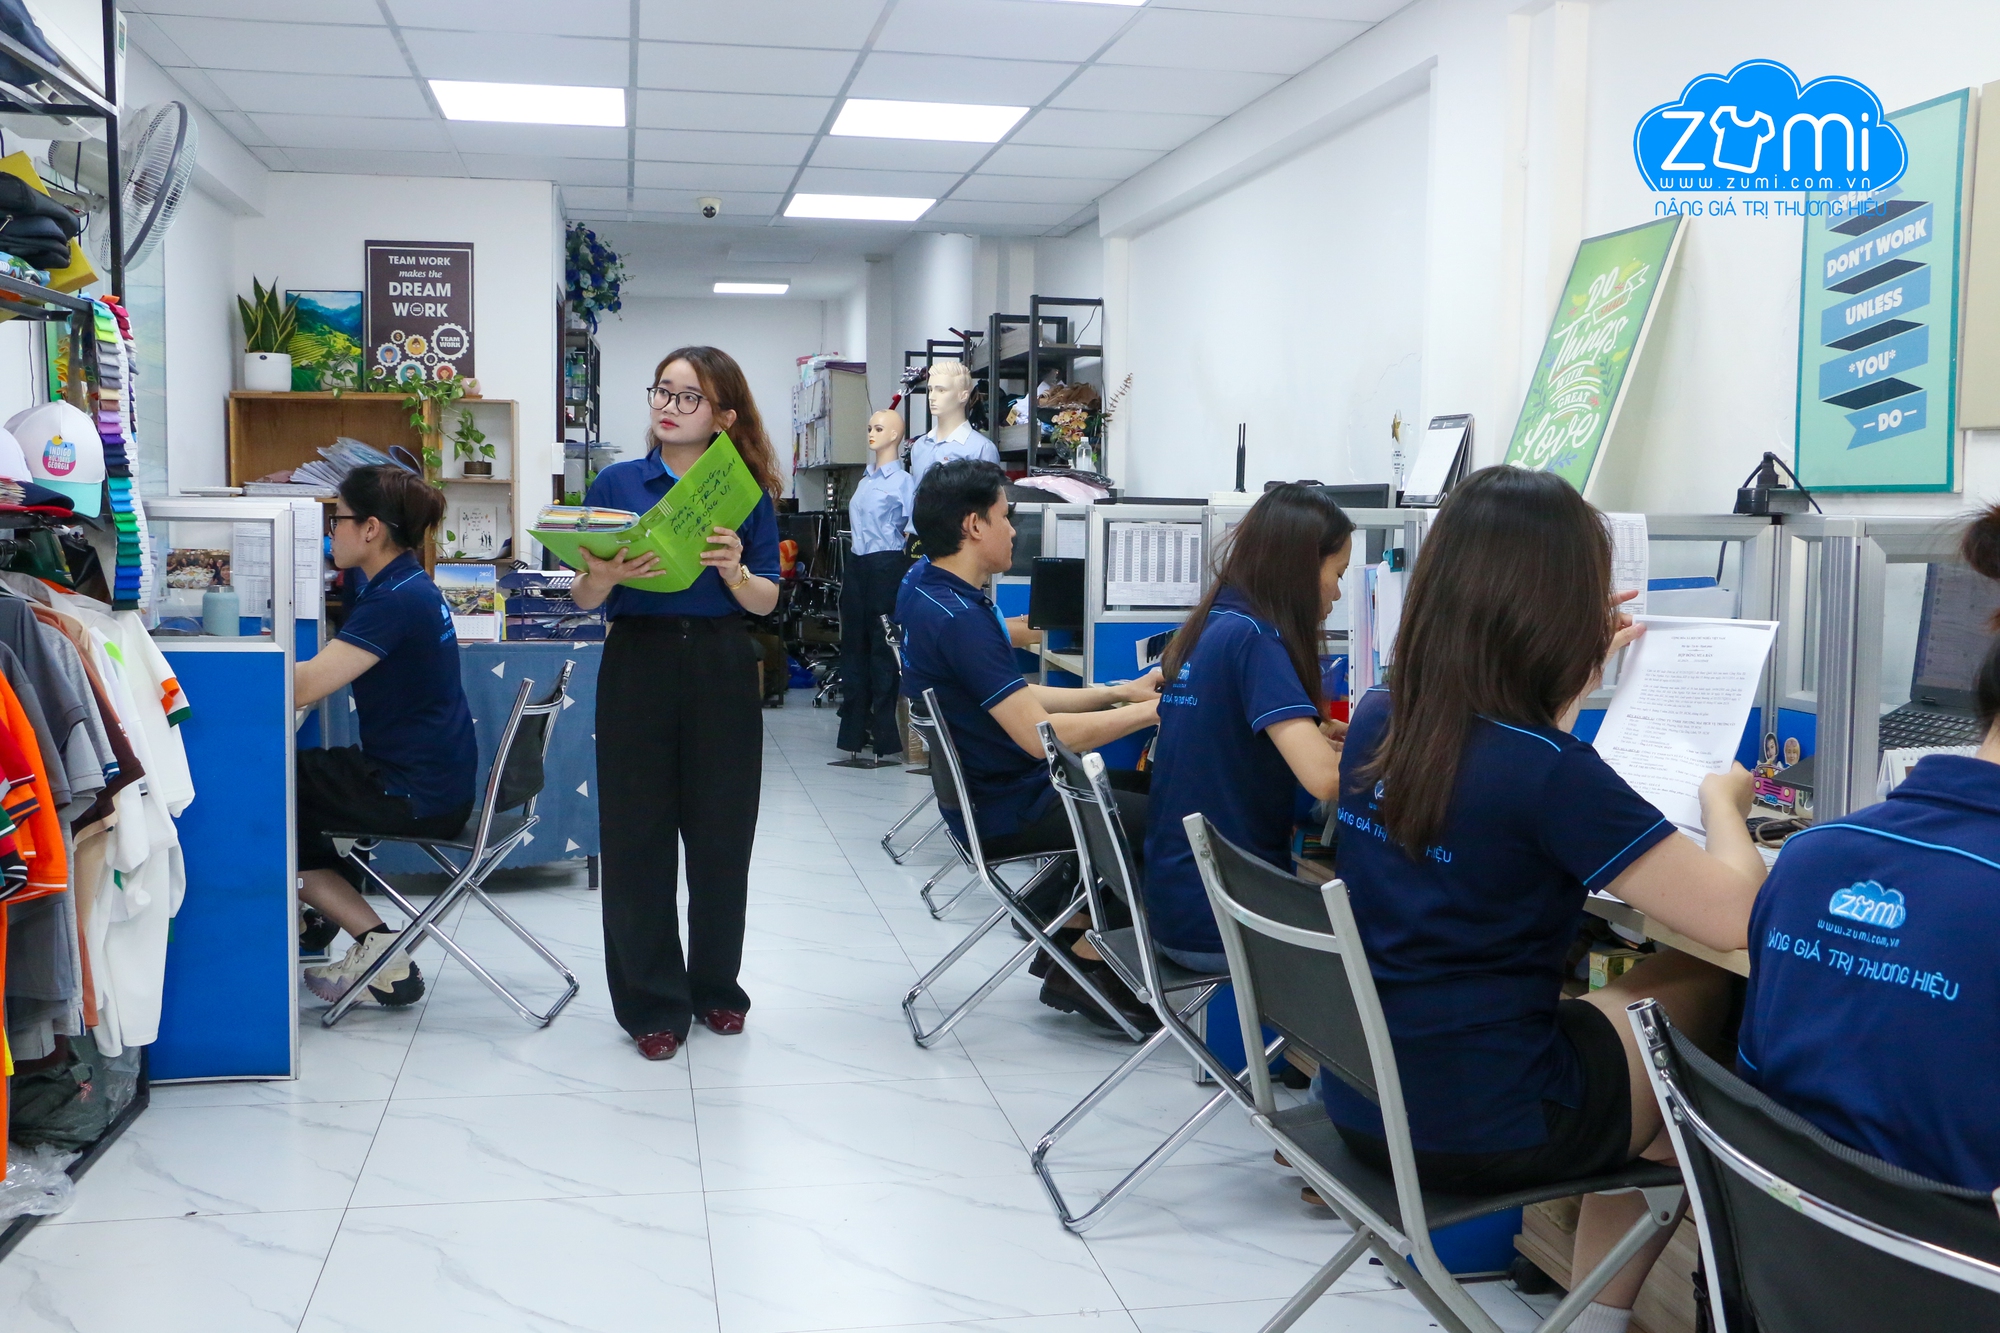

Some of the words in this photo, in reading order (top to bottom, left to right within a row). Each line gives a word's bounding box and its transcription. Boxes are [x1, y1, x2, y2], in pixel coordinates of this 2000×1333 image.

[1827, 241, 1873, 278] DON'T
[1876, 217, 1927, 256] WORK
[388, 256, 416, 265] TEAM
[419, 256, 451, 266] WORK
[399, 270, 426, 278] makes
[428, 270, 442, 278] the
[388, 282, 451, 297] DREAM
[392, 302, 448, 317] WORK
[1845, 287, 1903, 325] UNLESS
[1548, 313, 1629, 383] Things
[1556, 366, 1585, 389] WITH
[1557, 392, 1591, 409] GREAT
[50, 446, 71, 456] INDIGO
[48, 461, 69, 470] GEORGIA
[1356, 817, 1370, 833] GIÁ
[1794, 939, 1820, 962] GIÁ
[1828, 949, 1854, 976] TRỊ
[1911, 971, 1959, 1001] HIỆU
